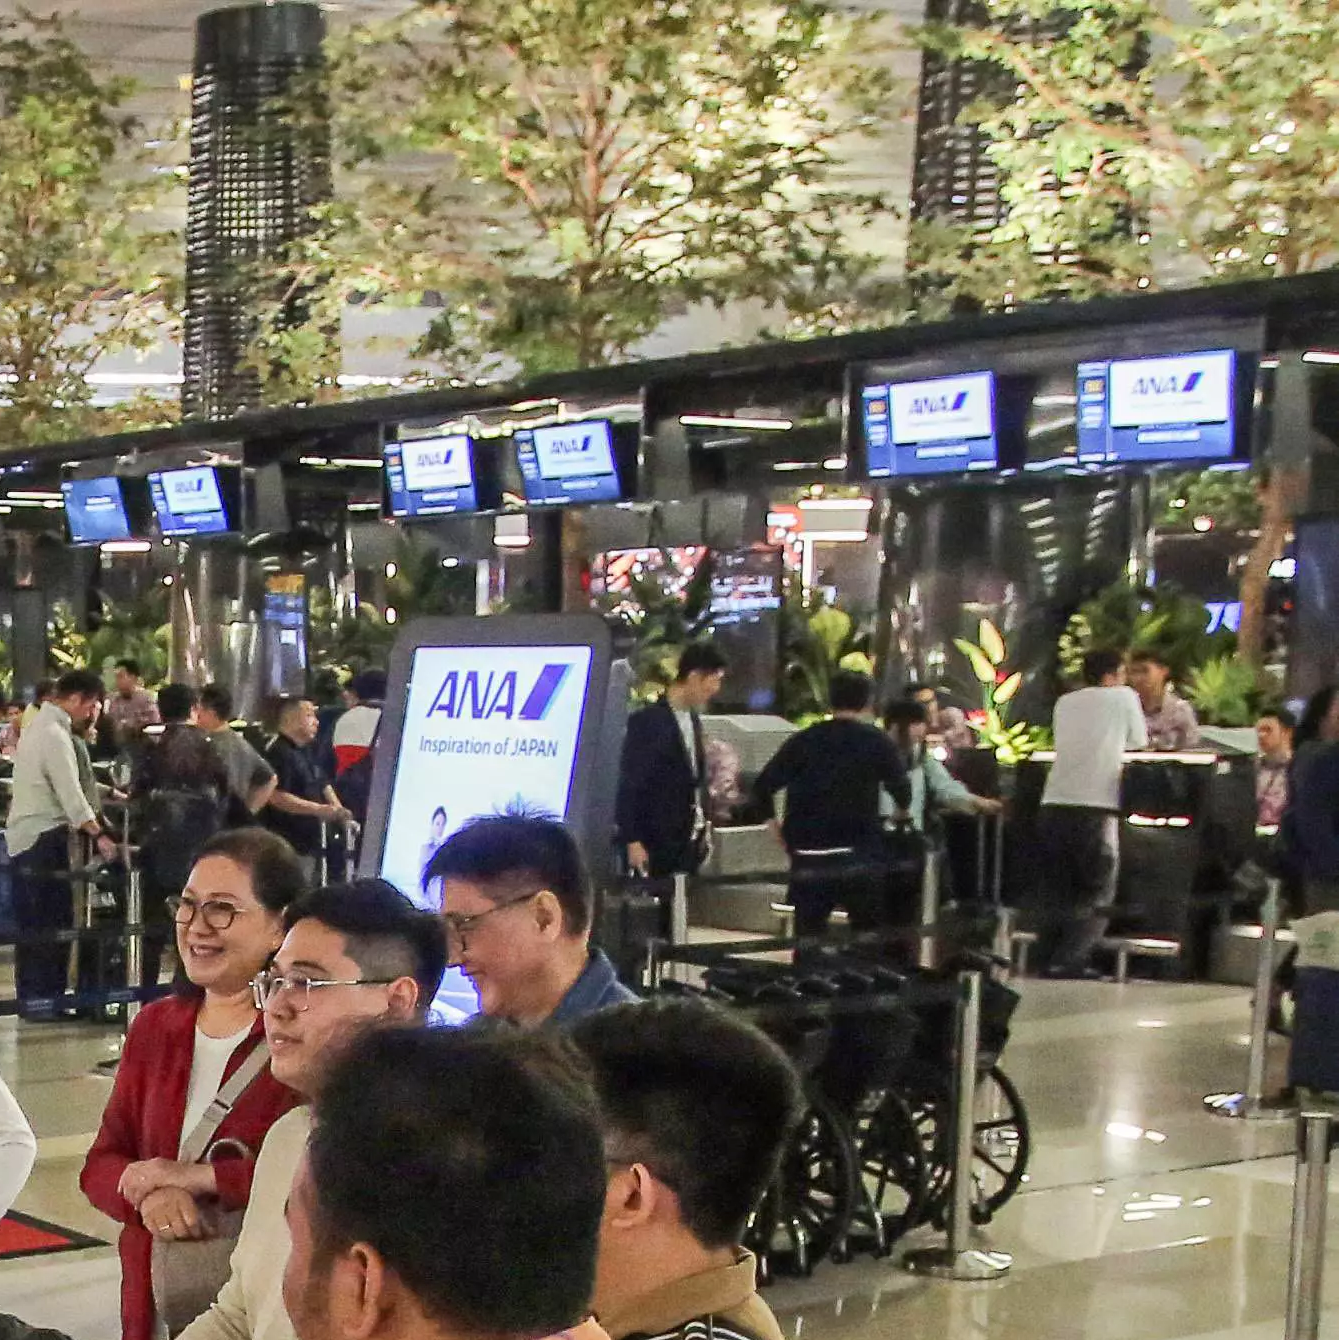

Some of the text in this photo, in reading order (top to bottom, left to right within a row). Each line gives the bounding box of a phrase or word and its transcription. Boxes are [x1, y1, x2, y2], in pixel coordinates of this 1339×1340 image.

[426, 670, 519, 720] ANA
[419, 735, 559, 758] Inspiration of JAPAN
